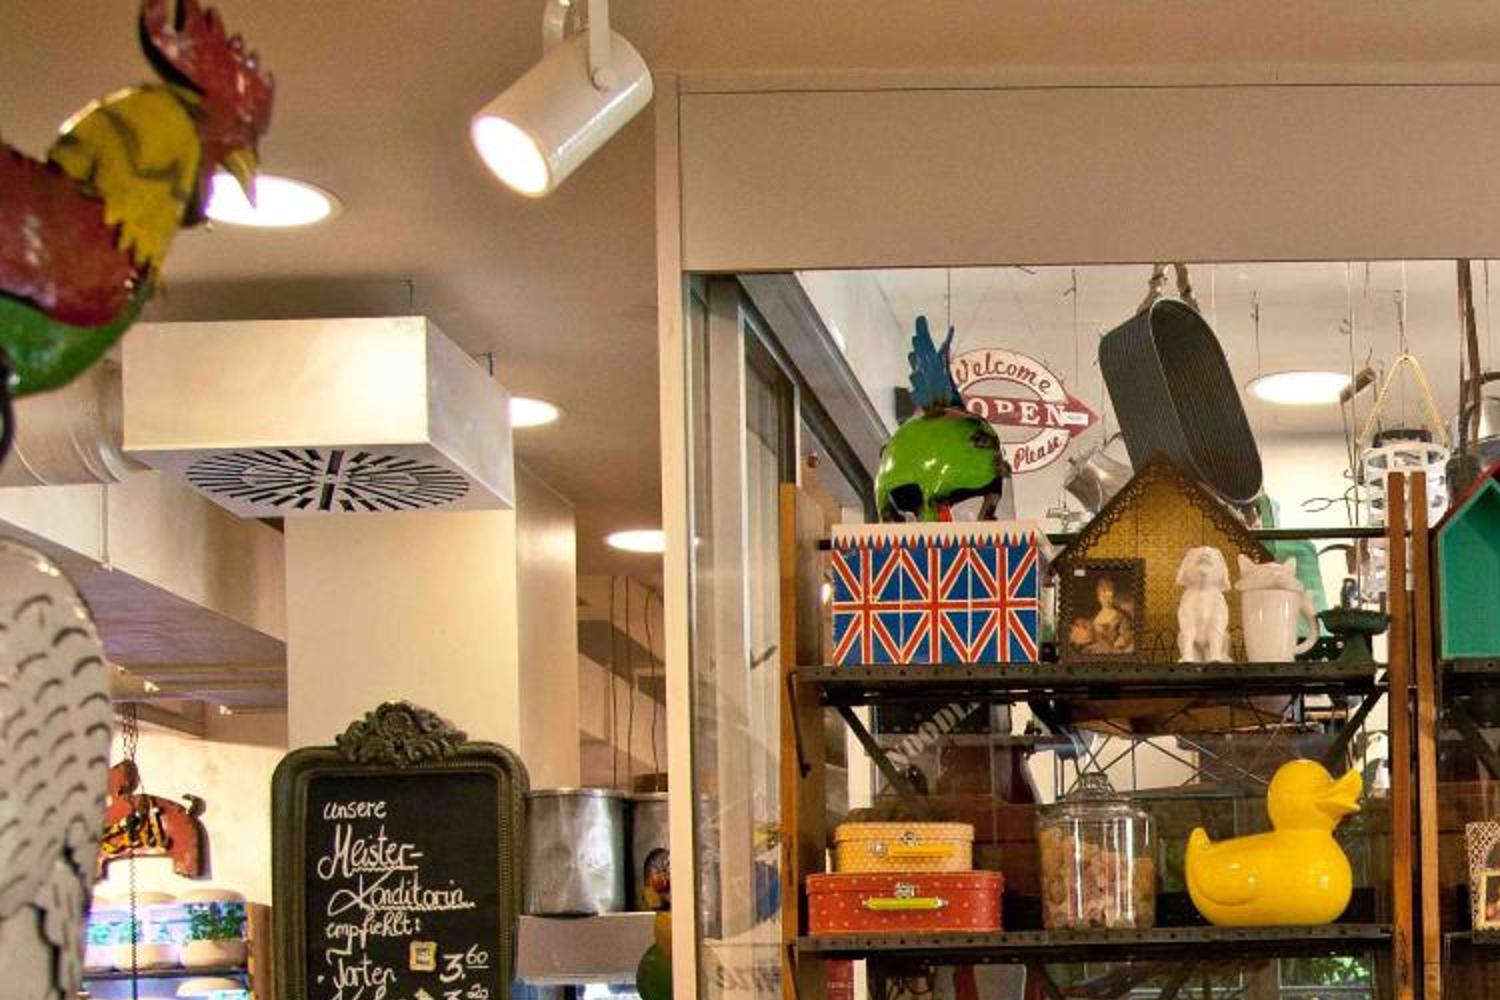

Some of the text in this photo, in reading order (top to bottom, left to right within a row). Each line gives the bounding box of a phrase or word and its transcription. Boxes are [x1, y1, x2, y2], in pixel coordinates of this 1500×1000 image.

[966, 398, 1066, 427] OPEN
[1013, 436, 1063, 471] Please
[323, 801, 388, 820] unsere
[325, 948, 397, 988] Torten
